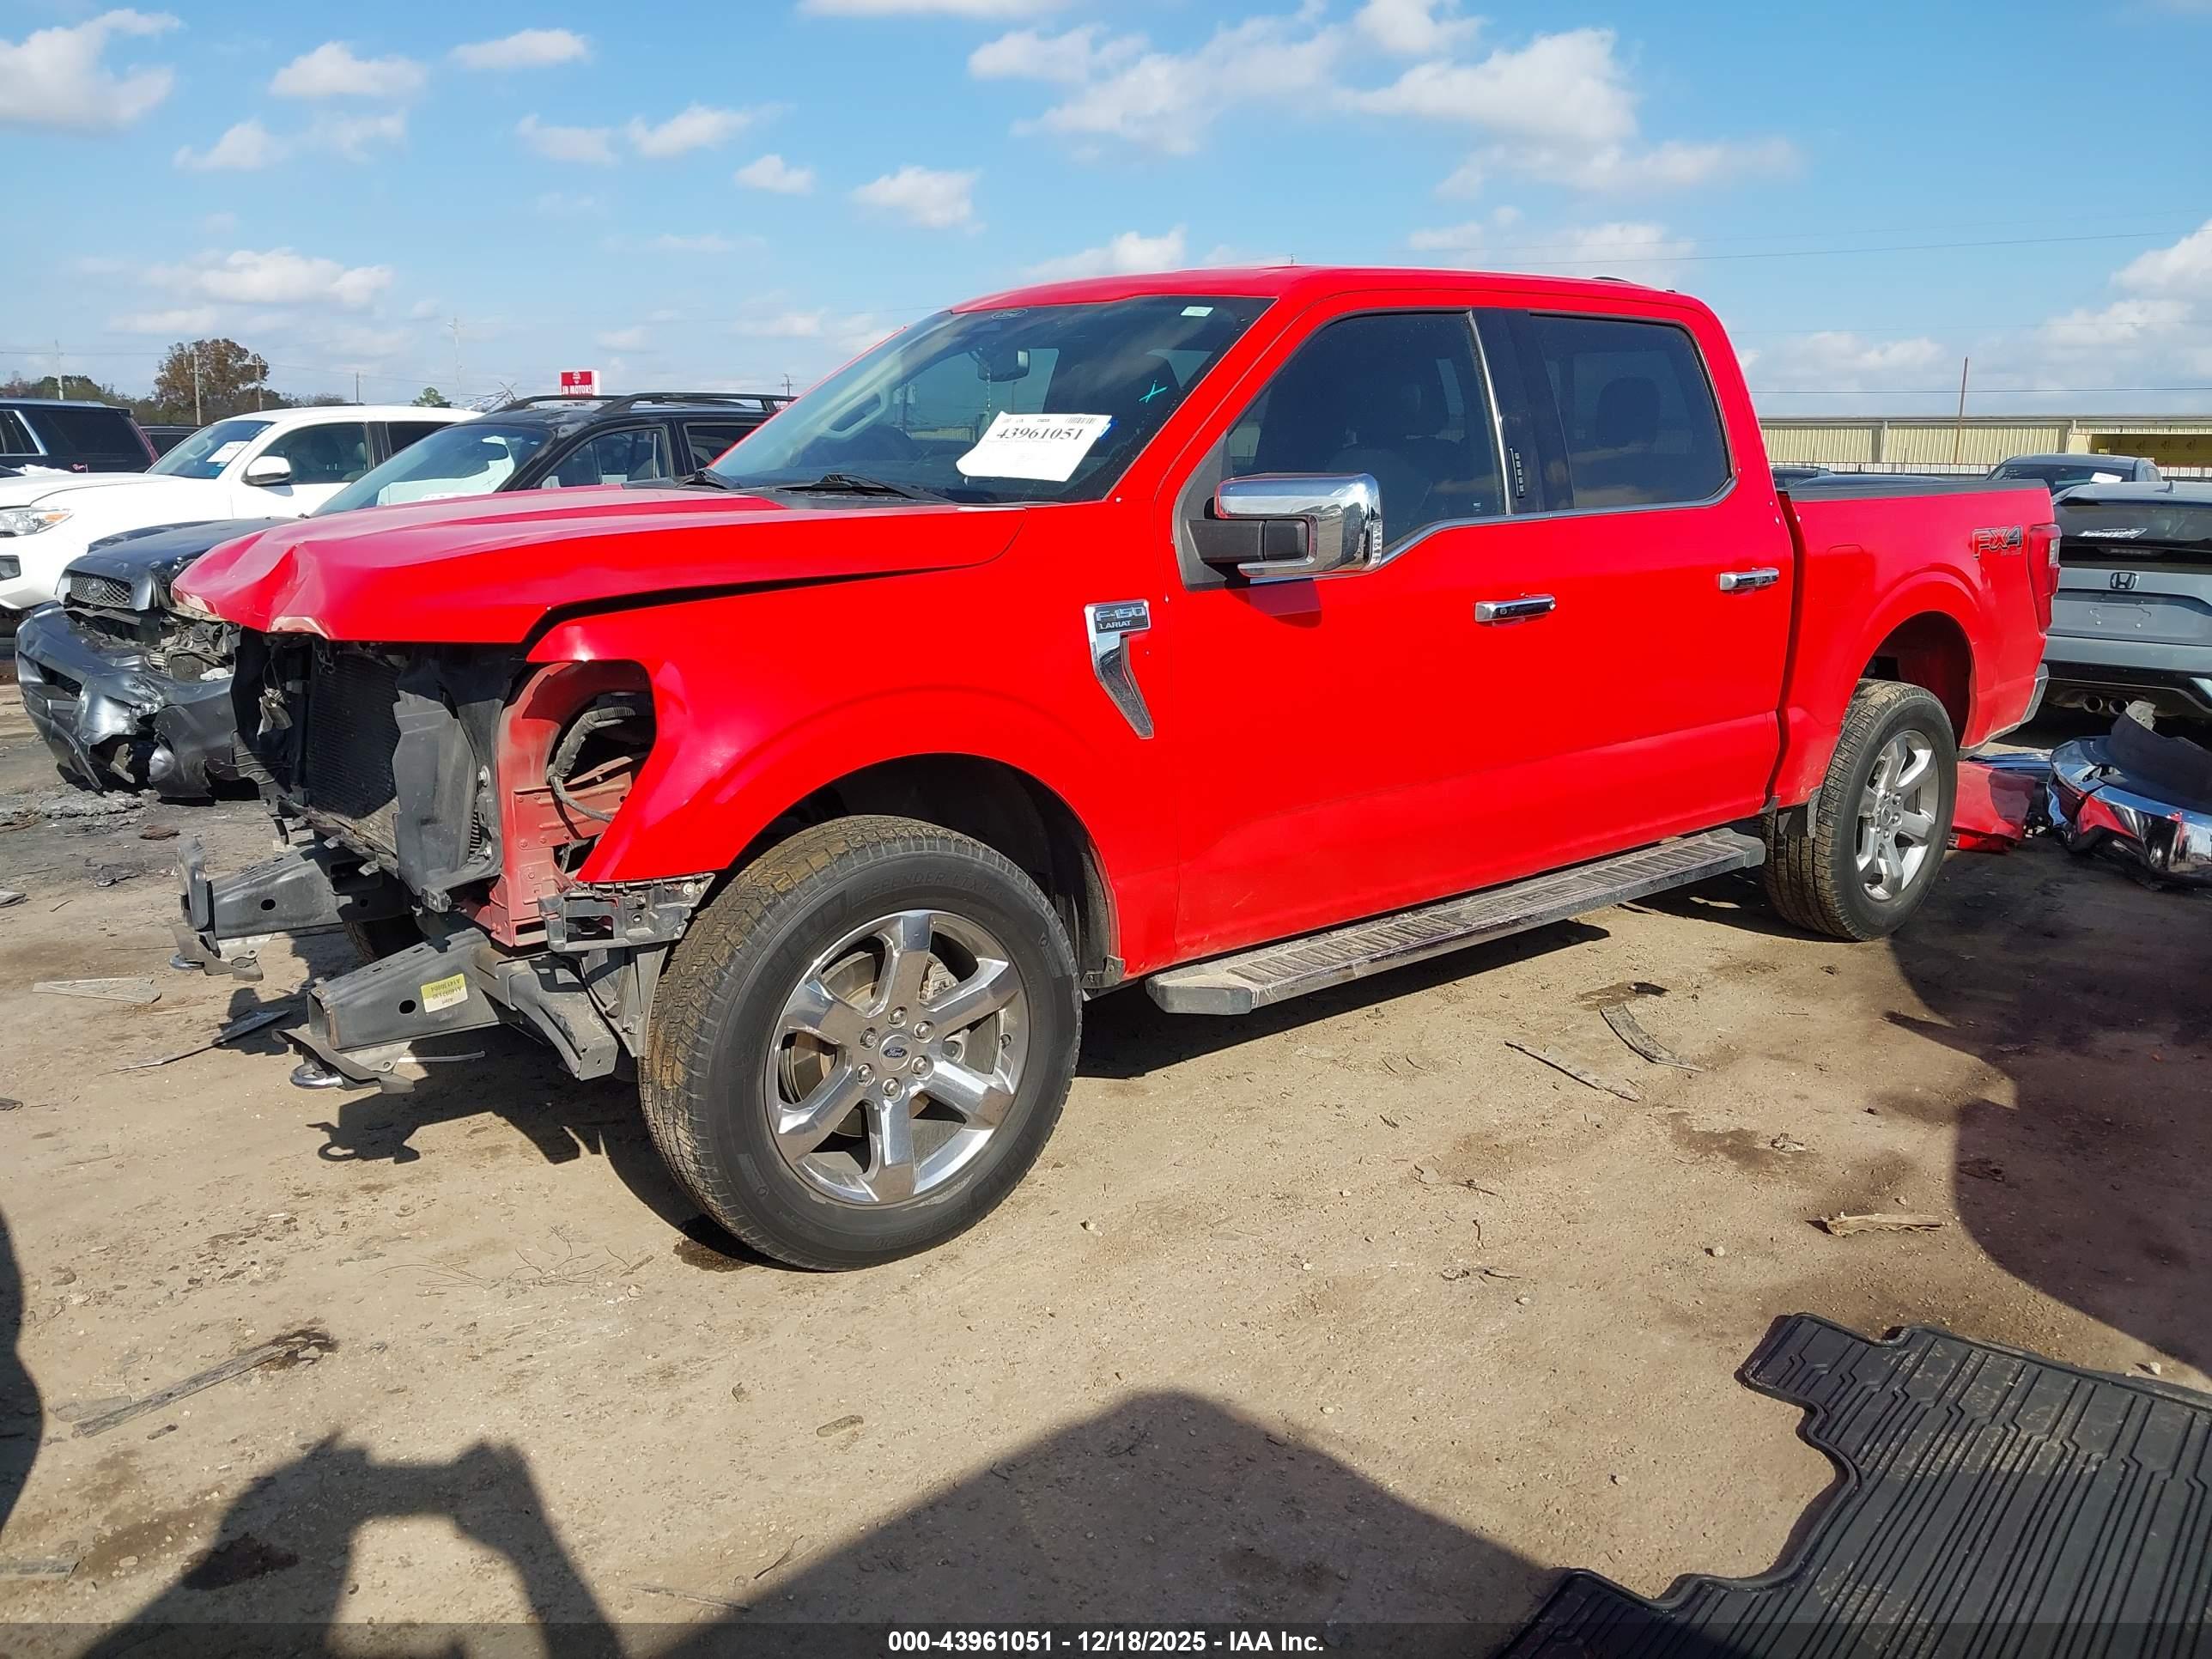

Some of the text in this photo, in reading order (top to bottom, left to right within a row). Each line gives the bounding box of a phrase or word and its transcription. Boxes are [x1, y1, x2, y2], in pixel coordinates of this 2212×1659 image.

[570, 384, 592, 394] MOTORS
[996, 427, 1085, 441] 43961051
[1972, 525, 2023, 560] FX4
[1096, 605, 1146, 621] F-150
[1099, 620, 1132, 630] LARIAT
